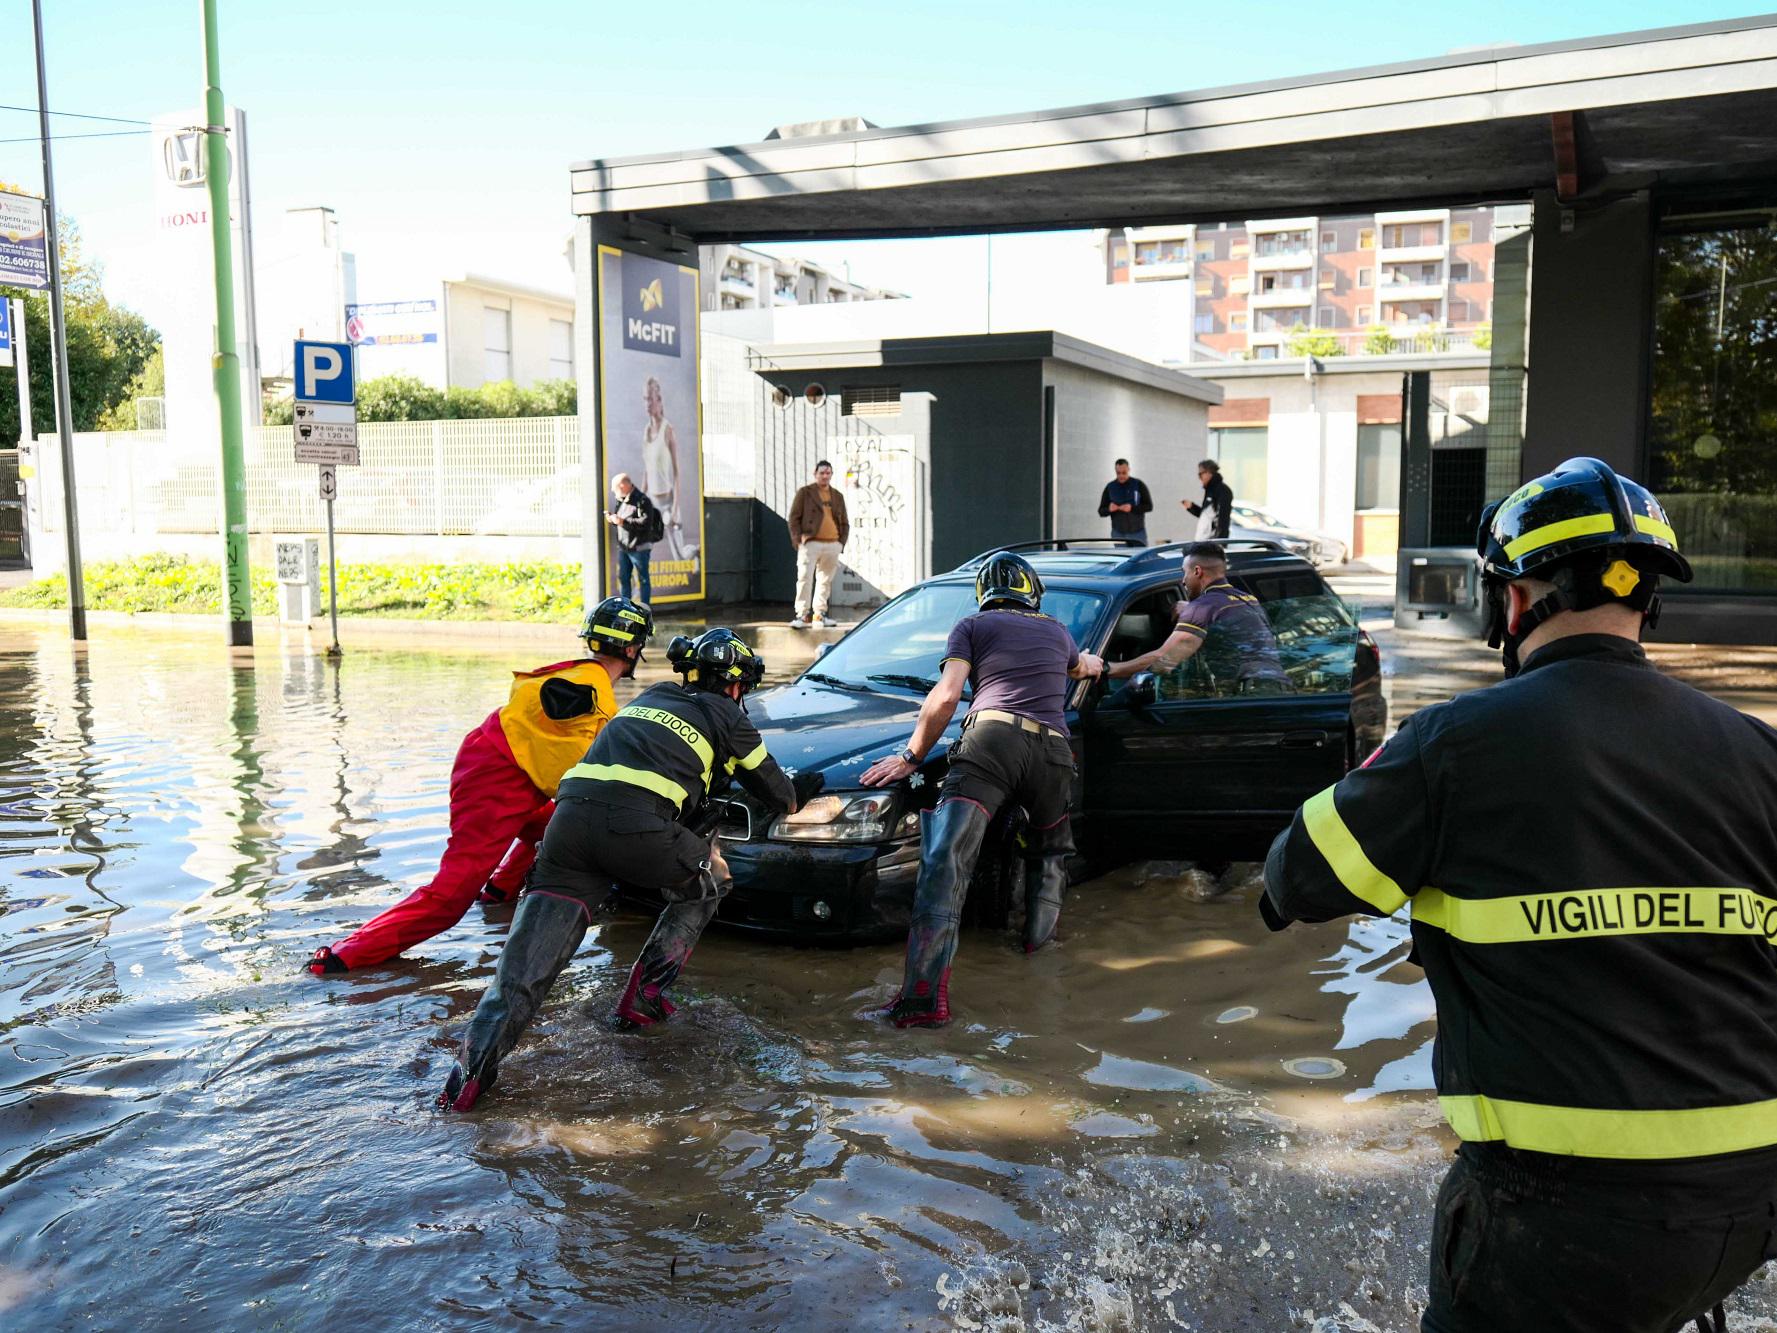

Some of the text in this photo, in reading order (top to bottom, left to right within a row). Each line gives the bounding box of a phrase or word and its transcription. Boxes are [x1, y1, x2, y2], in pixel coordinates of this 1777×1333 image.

[628, 317, 676, 345] McFIT
[304, 345, 343, 396] P
[628, 707, 699, 744] DEL FUOCO
[1519, 894, 1625, 935] VIGILI
[1633, 893, 1705, 928] DEL
